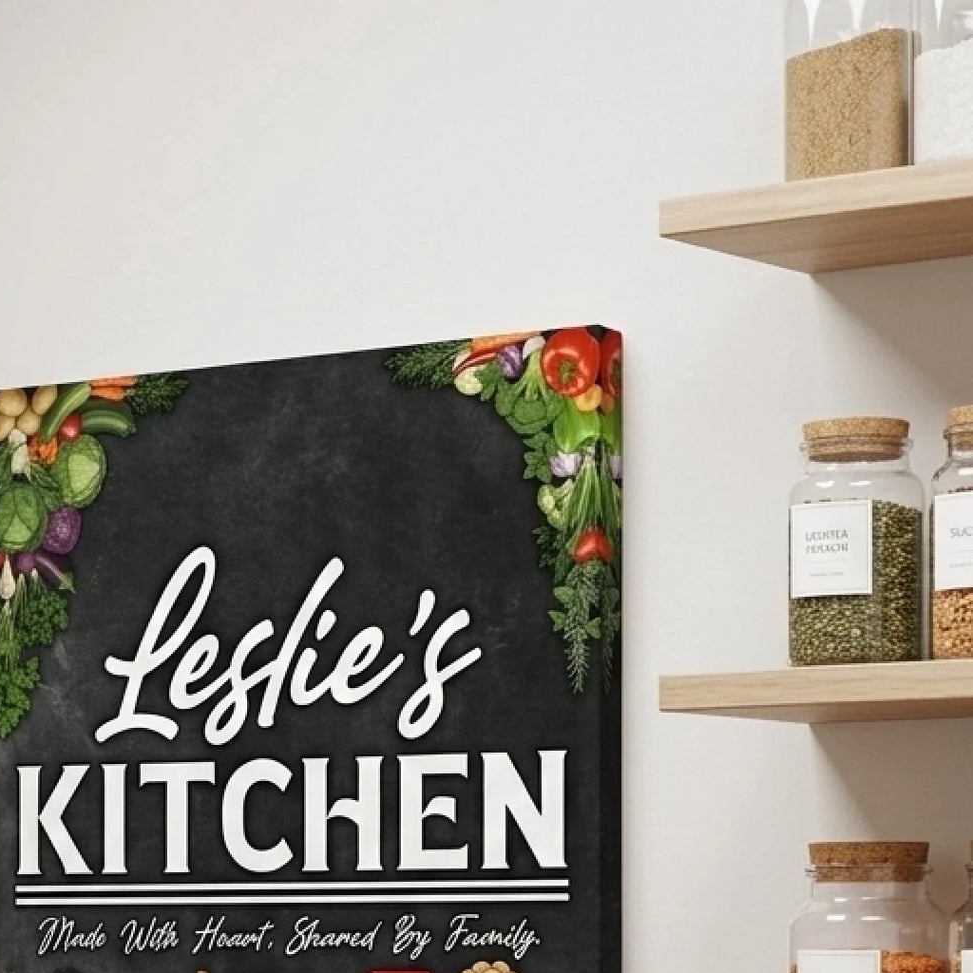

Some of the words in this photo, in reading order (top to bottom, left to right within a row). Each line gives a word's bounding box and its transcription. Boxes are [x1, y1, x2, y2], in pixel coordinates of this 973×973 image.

[95, 546, 482, 746] Leslie's
[16, 750, 568, 875] KITCHEN
[38, 915, 106, 955] Made
[120, 916, 179, 955] With
[285, 915, 383, 955] Shared
[393, 913, 432, 960] By
